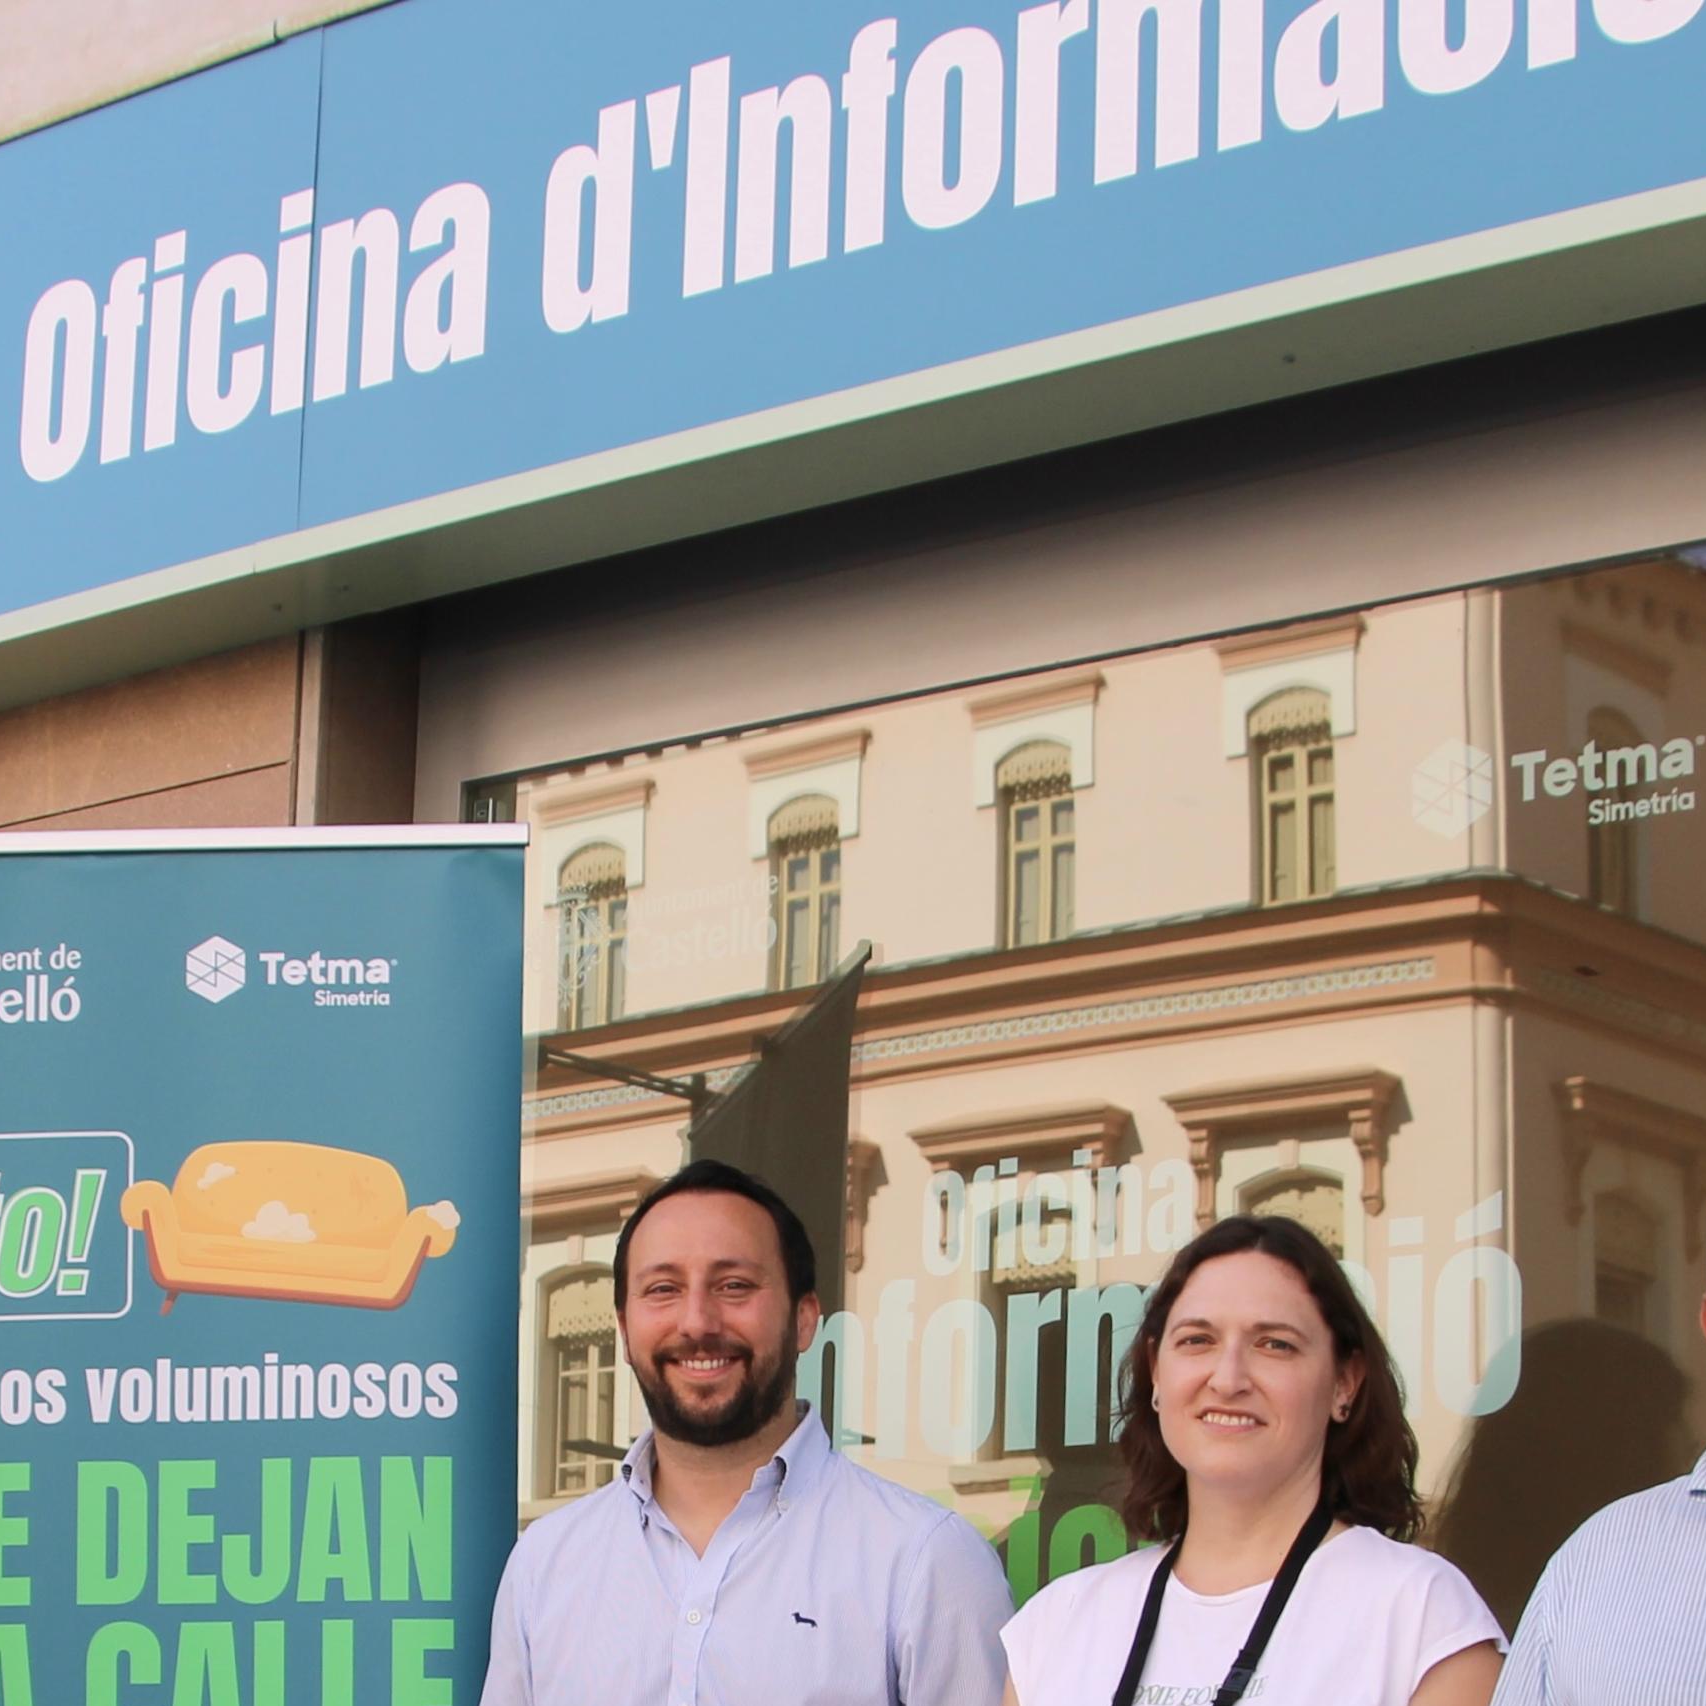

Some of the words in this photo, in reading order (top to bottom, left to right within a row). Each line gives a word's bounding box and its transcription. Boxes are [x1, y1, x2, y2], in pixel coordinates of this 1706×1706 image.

[19, 182, 492, 484] Oficina
[542, 0, 1705, 335] d'Informa
[1510, 738, 1696, 802] Tetma
[50, 942, 82, 970] de
[258, 950, 391, 986] Tetma
[922, 1148, 1195, 1277] Oficina
[85, 1352, 458, 1423] voluminosos
[76, 1455, 454, 1606] DEJAN
